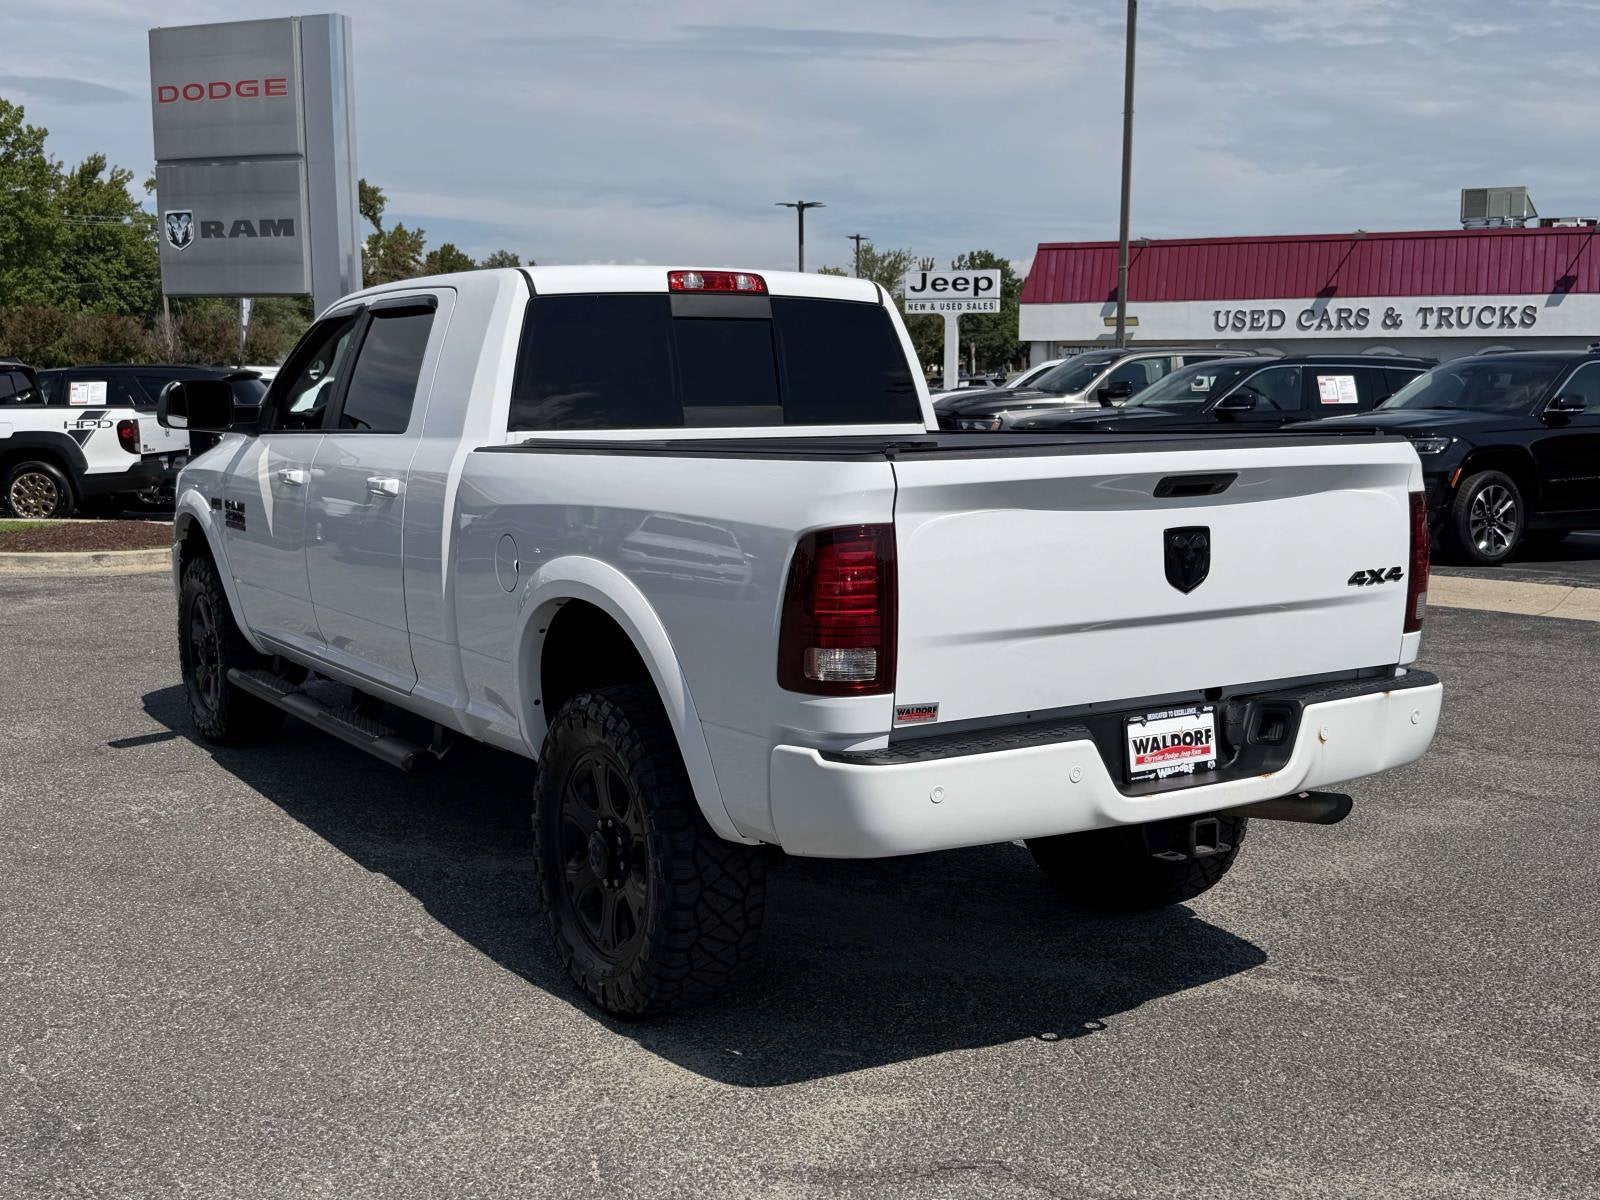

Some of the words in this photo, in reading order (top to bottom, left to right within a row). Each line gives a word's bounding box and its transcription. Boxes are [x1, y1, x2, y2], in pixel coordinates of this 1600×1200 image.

[157, 78, 288, 103] DODGE
[200, 219, 295, 238] RAM
[910, 273, 993, 297] Jeep
[908, 303, 926, 311] NEW
[940, 303, 963, 311] USED
[966, 302, 994, 310] SALES
[1213, 309, 1286, 332] USED
[1296, 308, 1370, 331] CARS
[1381, 306, 1403, 330] &
[1416, 305, 1537, 330] TRUCKS
[64, 420, 114, 429] HPD
[897, 706, 937, 716] WALDORF
[1132, 728, 1212, 755] WALDORF
[1157, 763, 1195, 779] WALDORF
